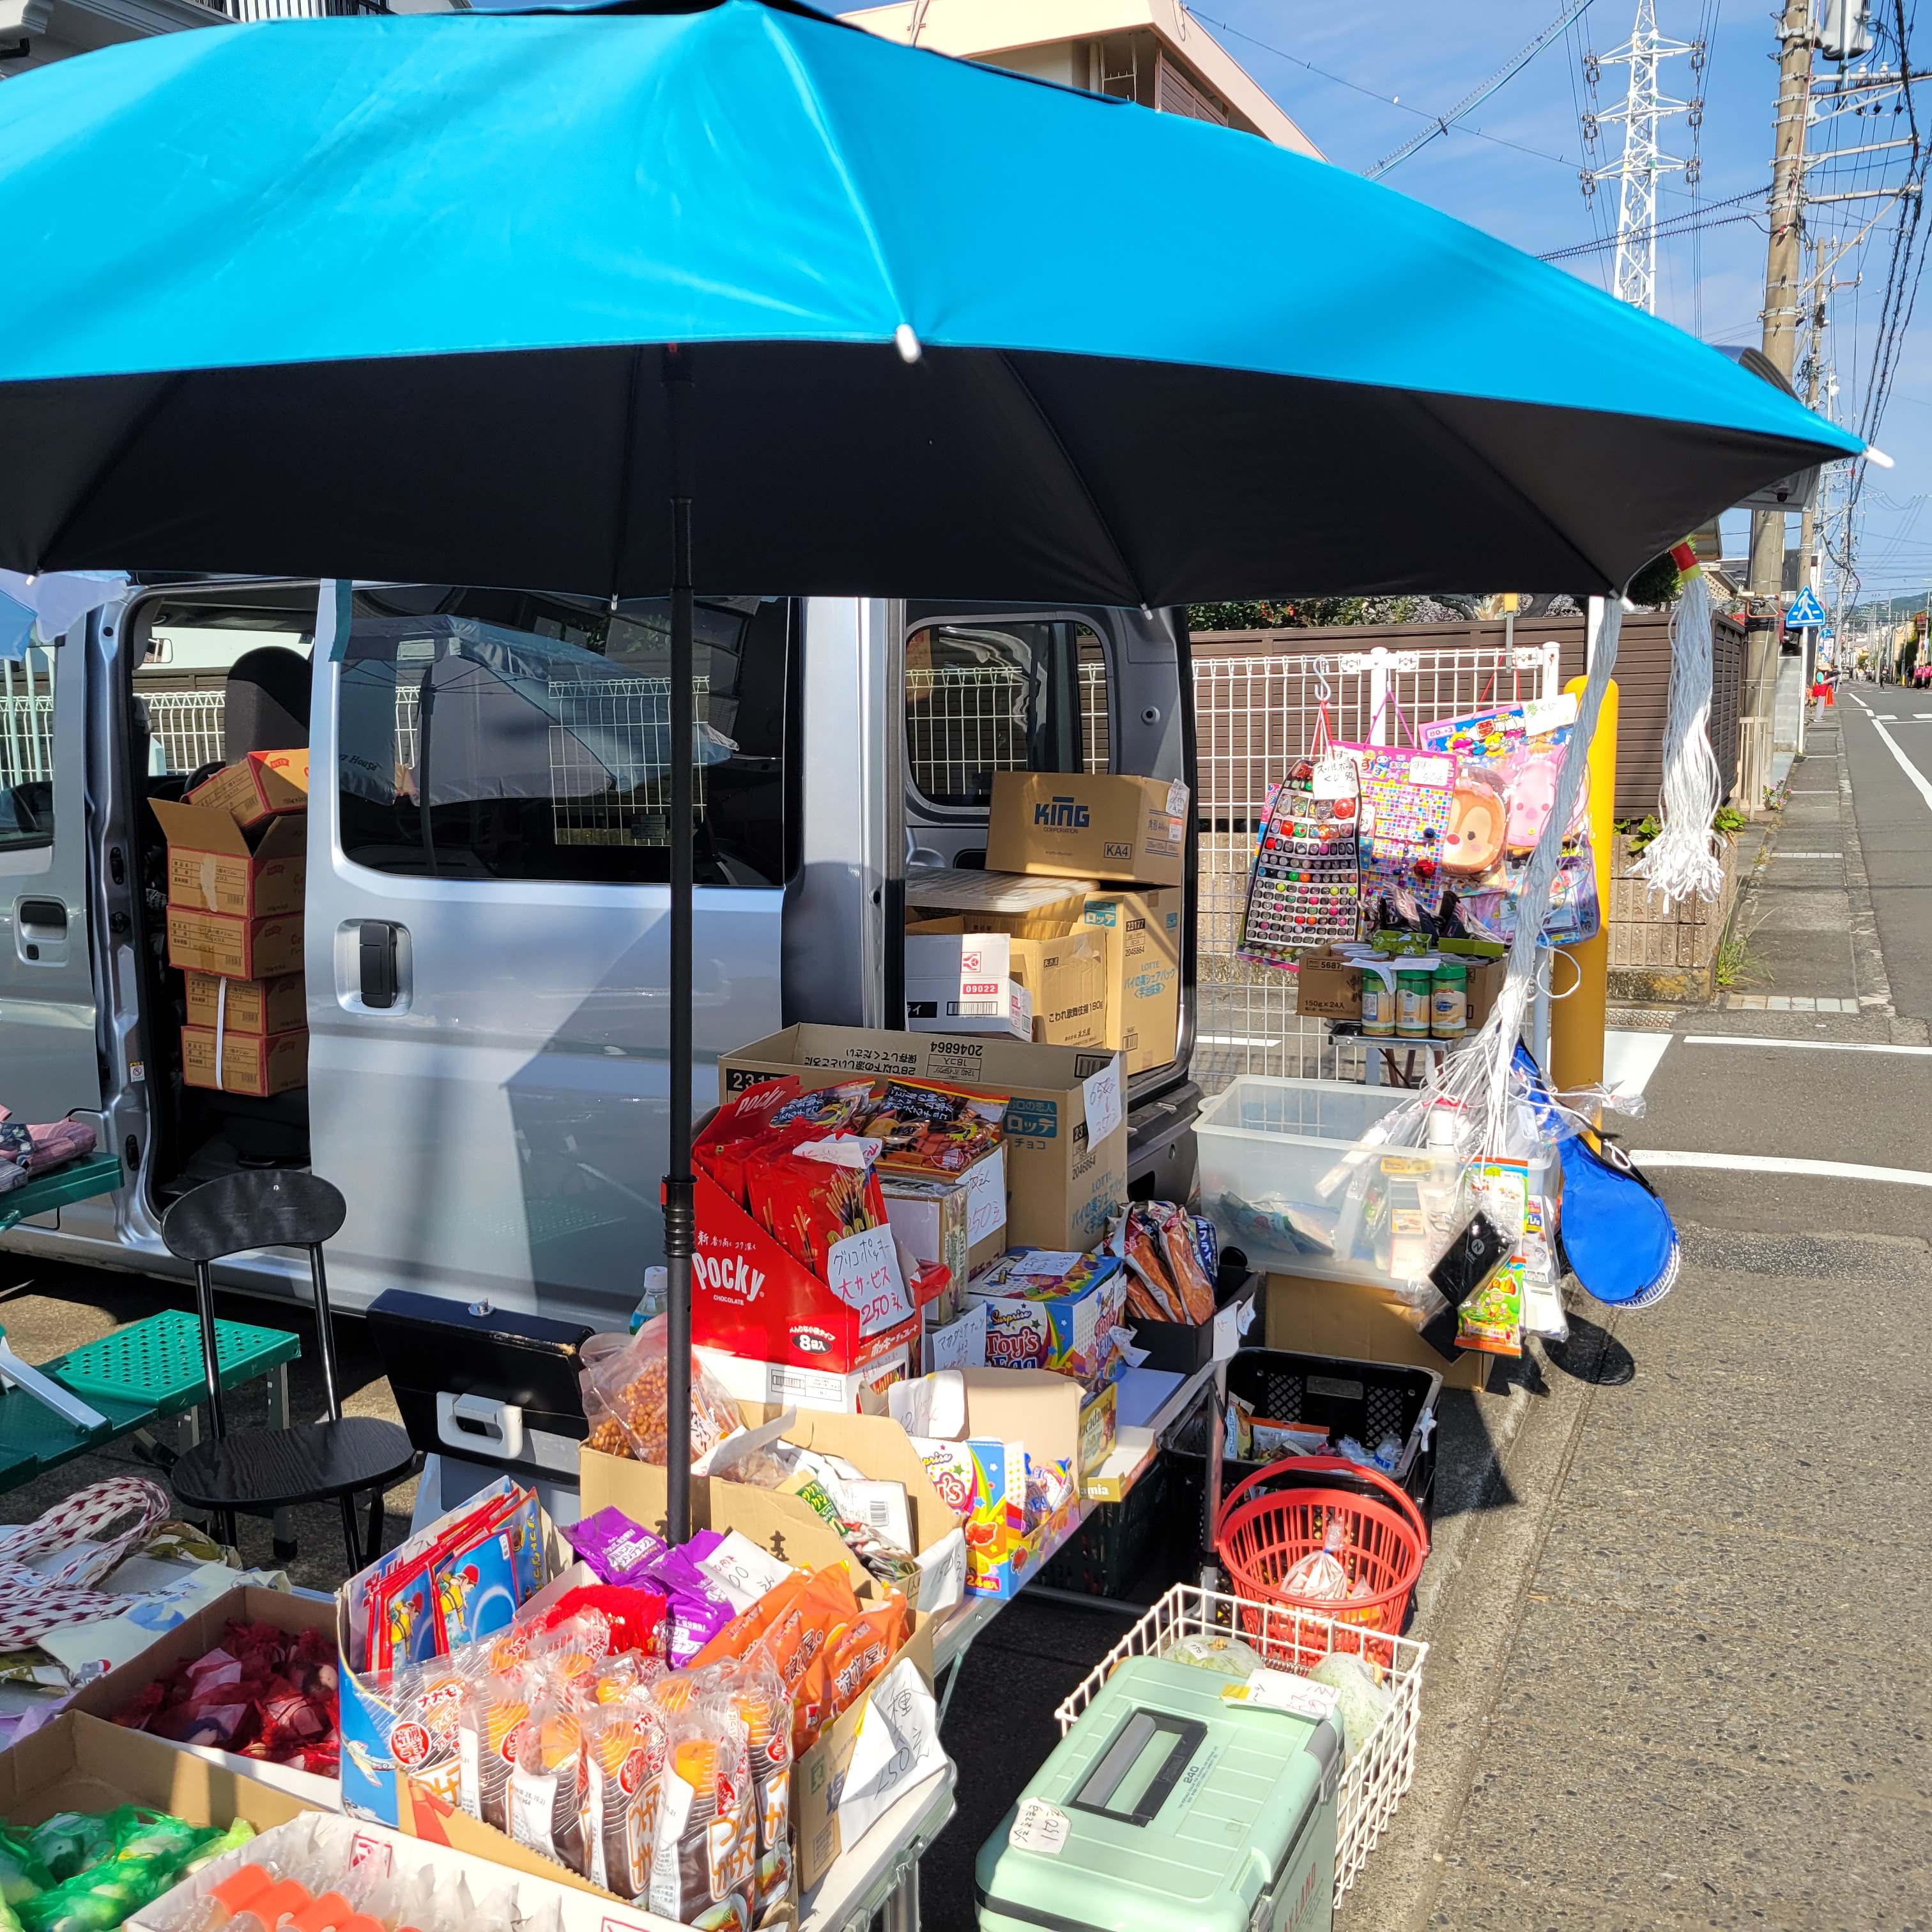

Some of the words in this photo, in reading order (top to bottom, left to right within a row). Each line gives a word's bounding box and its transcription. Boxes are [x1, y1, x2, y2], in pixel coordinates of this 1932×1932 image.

[1034, 797, 1090, 827] KING
[1107, 845, 1128, 857] KA4
[1086, 912, 1116, 924] ロッテ
[1127, 919, 1145, 931] 23177
[1141, 961, 1160, 971] LOTTE
[1321, 960, 1340, 969] 5687
[965, 985, 996, 993] 09022
[846, 1048, 917, 1064] 保存してください
[930, 1041, 983, 1056] 2046864
[1006, 1117, 1055, 1133] ロッテ
[1014, 1138, 1045, 1149] チョコ
[697, 1230, 709, 1245] 新
[691, 1253, 766, 1301] Pocky
[713, 1294, 744, 1306] CHOCOLATE
[991, 1309, 1032, 1325] Surprise
[799, 1334, 827, 1351] 8袋入
[986, 1328, 1039, 1359] Toy's
[417, 1684, 459, 1708] ナカモ
[1183, 1766, 1200, 1784] 240
